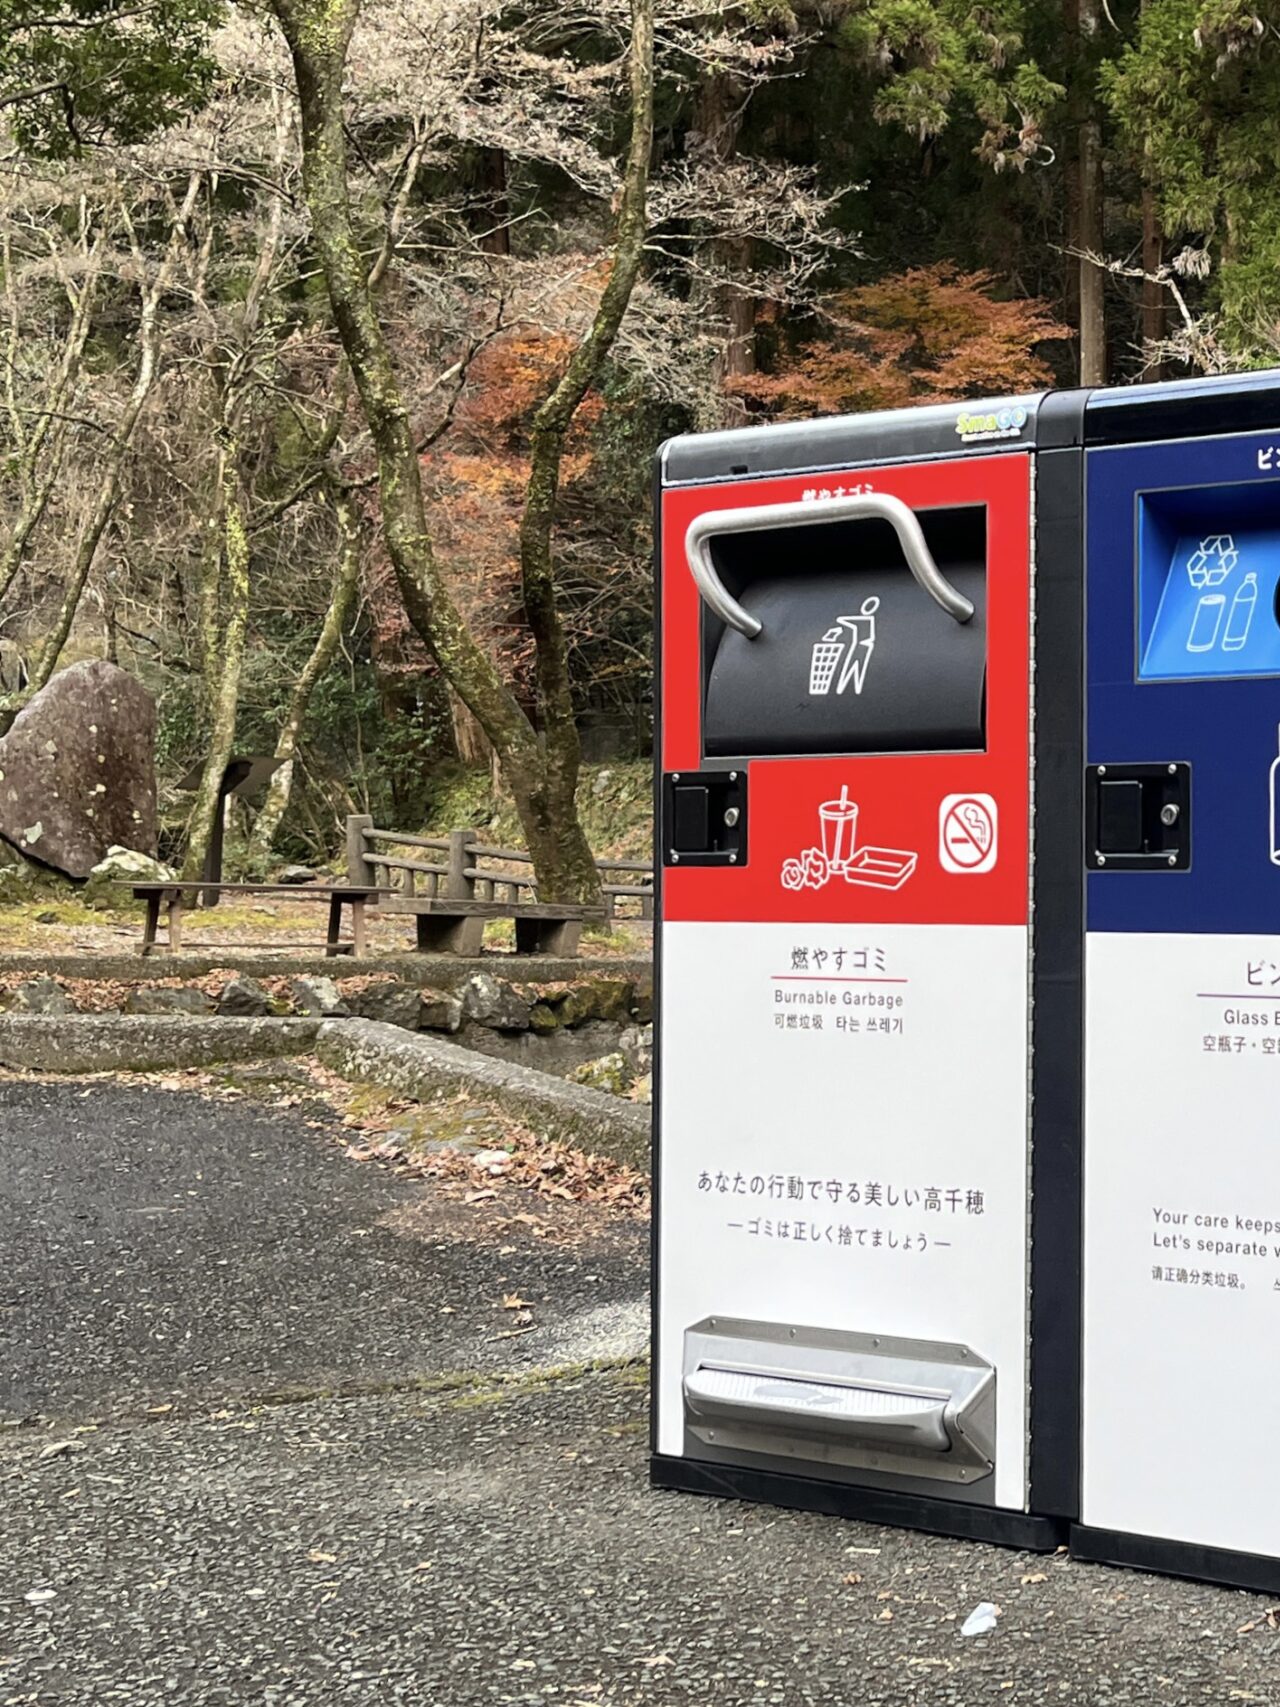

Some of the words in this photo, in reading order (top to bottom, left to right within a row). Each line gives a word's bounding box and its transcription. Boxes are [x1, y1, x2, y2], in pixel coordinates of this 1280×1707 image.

[955, 407, 1027, 434] SmaGO
[791, 946, 886, 972] 燃やすゴミ
[774, 989, 836, 1005] Burnable
[842, 991, 904, 1010] Garbage
[774, 1013, 823, 1030] 可燃垃圾
[836, 1016, 861, 1033] 타는
[866, 1018, 903, 1034] 쓰레기
[1224, 1009, 1269, 1025] Glass
[698, 1170, 985, 1216] あなたの行動で守る美しい高千穂
[1153, 1208, 1188, 1225] Your
[1194, 1214, 1229, 1229] care
[1153, 1232, 1191, 1250] Let's
[1197, 1238, 1268, 1256] separate
